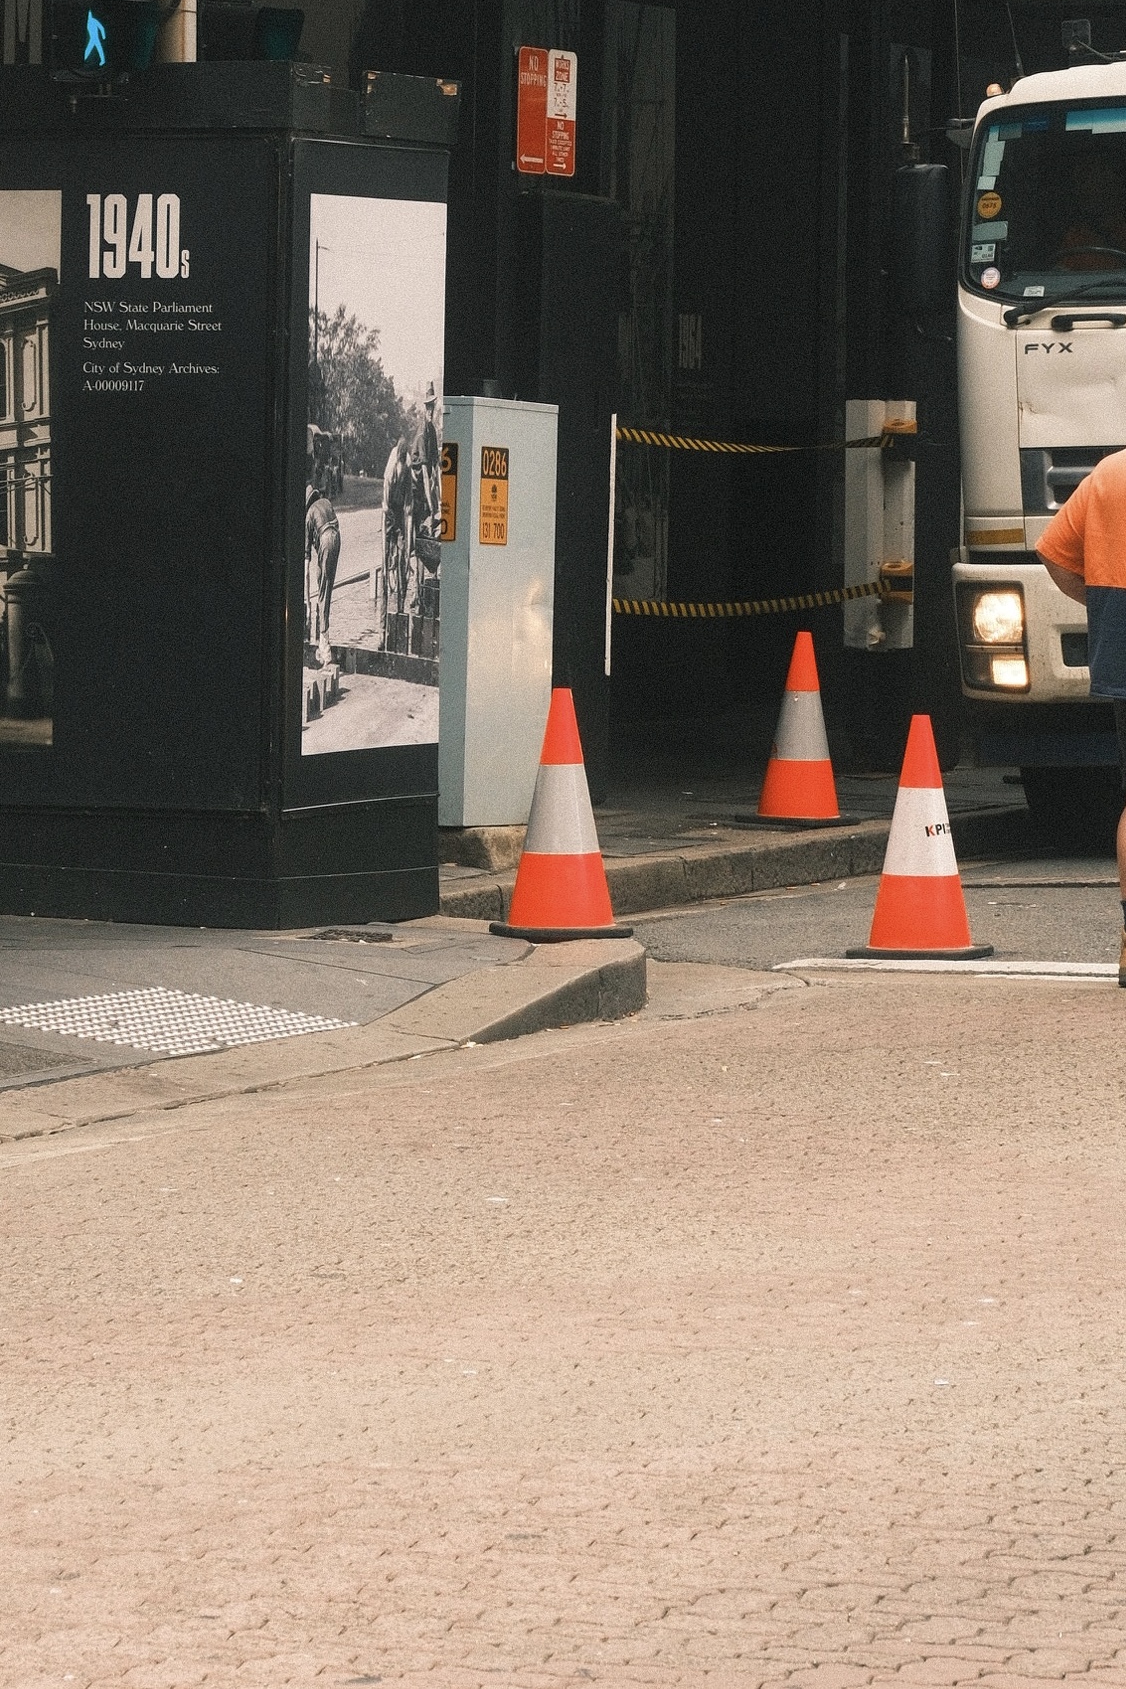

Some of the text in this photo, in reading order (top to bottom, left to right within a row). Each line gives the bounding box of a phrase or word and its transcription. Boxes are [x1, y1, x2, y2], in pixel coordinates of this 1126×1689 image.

[529, 55, 539, 71] NO
[520, 72, 547, 87] STOPPING
[87, 193, 190, 279] 1940s
[84, 301, 213, 313] NSW State Parliament
[83, 319, 222, 333] House, Macquarie Street
[83, 337, 125, 349] Sydney
[1024, 342, 1073, 355] FYX
[82, 362, 220, 376] City of Sydney Archives:
[482, 449, 507, 477] 0286
[482, 522, 505, 540] 131 700
[925, 823, 946, 837] KPI
